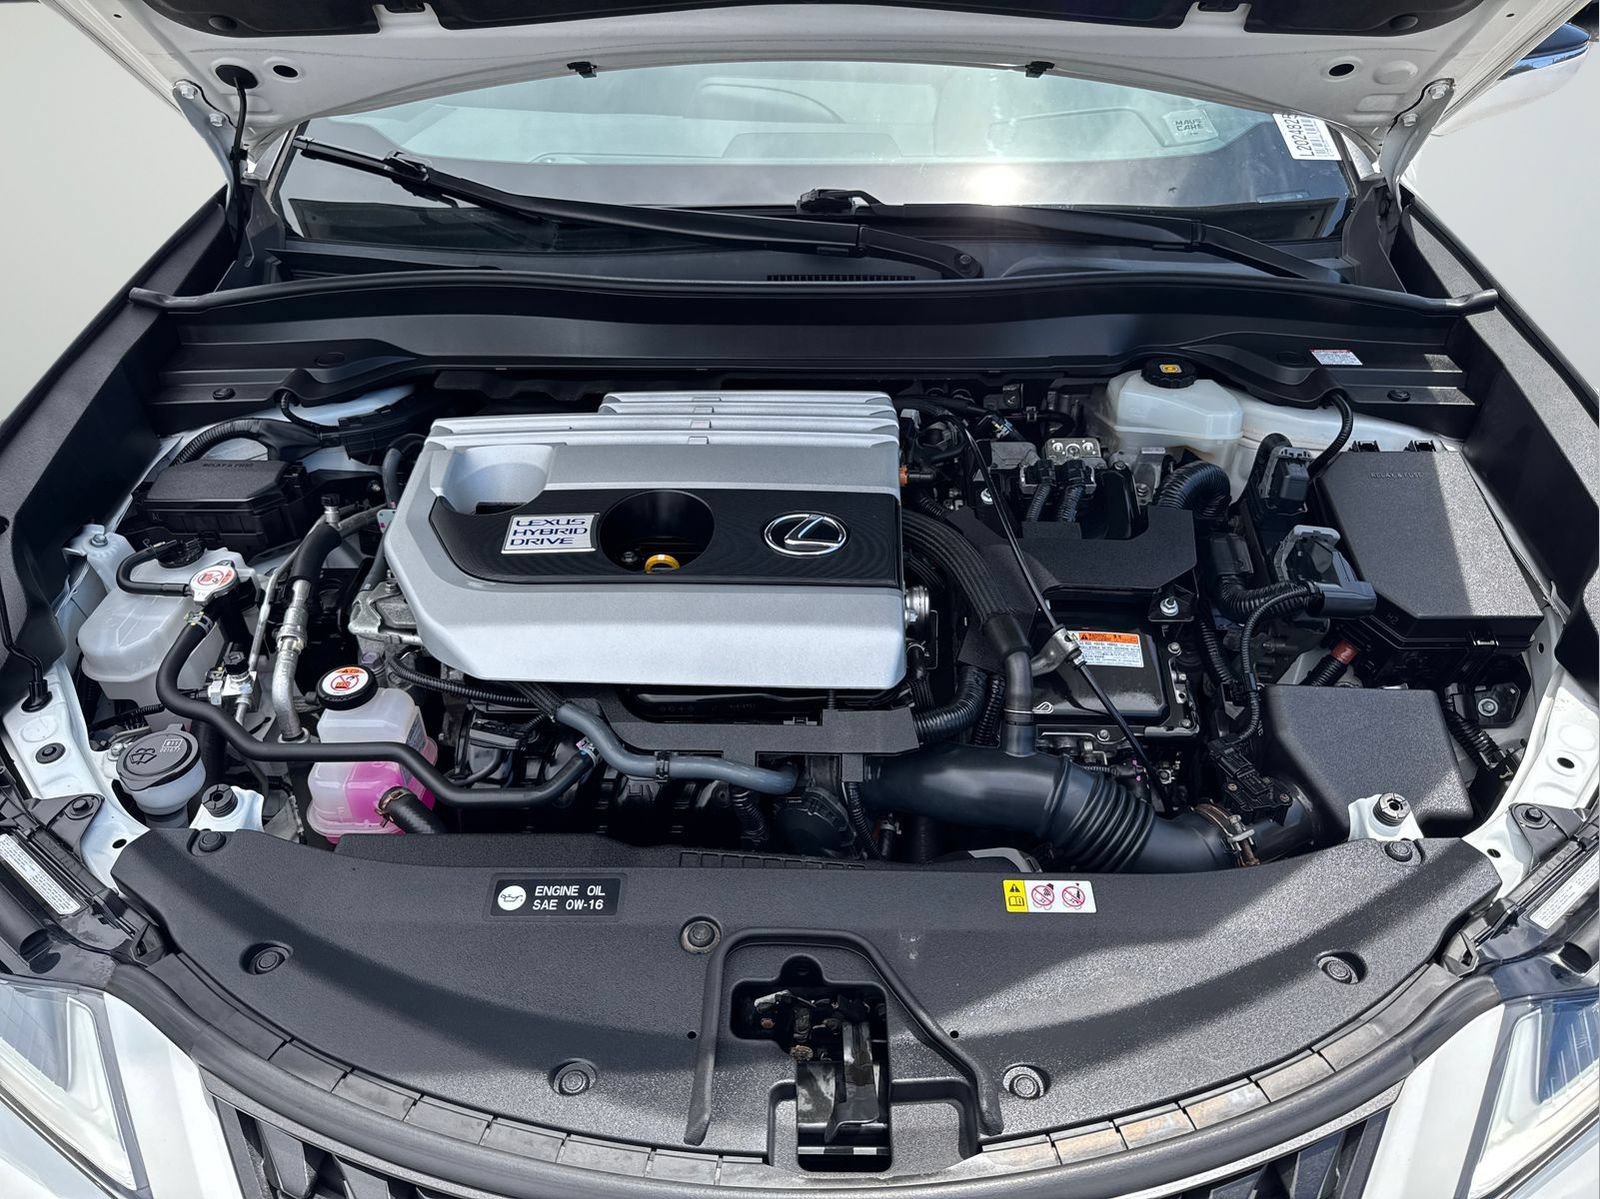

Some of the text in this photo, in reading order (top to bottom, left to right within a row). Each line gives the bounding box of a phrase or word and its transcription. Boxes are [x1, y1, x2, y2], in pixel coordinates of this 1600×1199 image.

[516, 518, 586, 527] LEXUS
[513, 527, 588, 537] HYBRID
[510, 537, 575, 546] DRIVE
[534, 885, 606, 896] ENGINE OIL
[532, 899, 604, 910] SAE 0W-16
